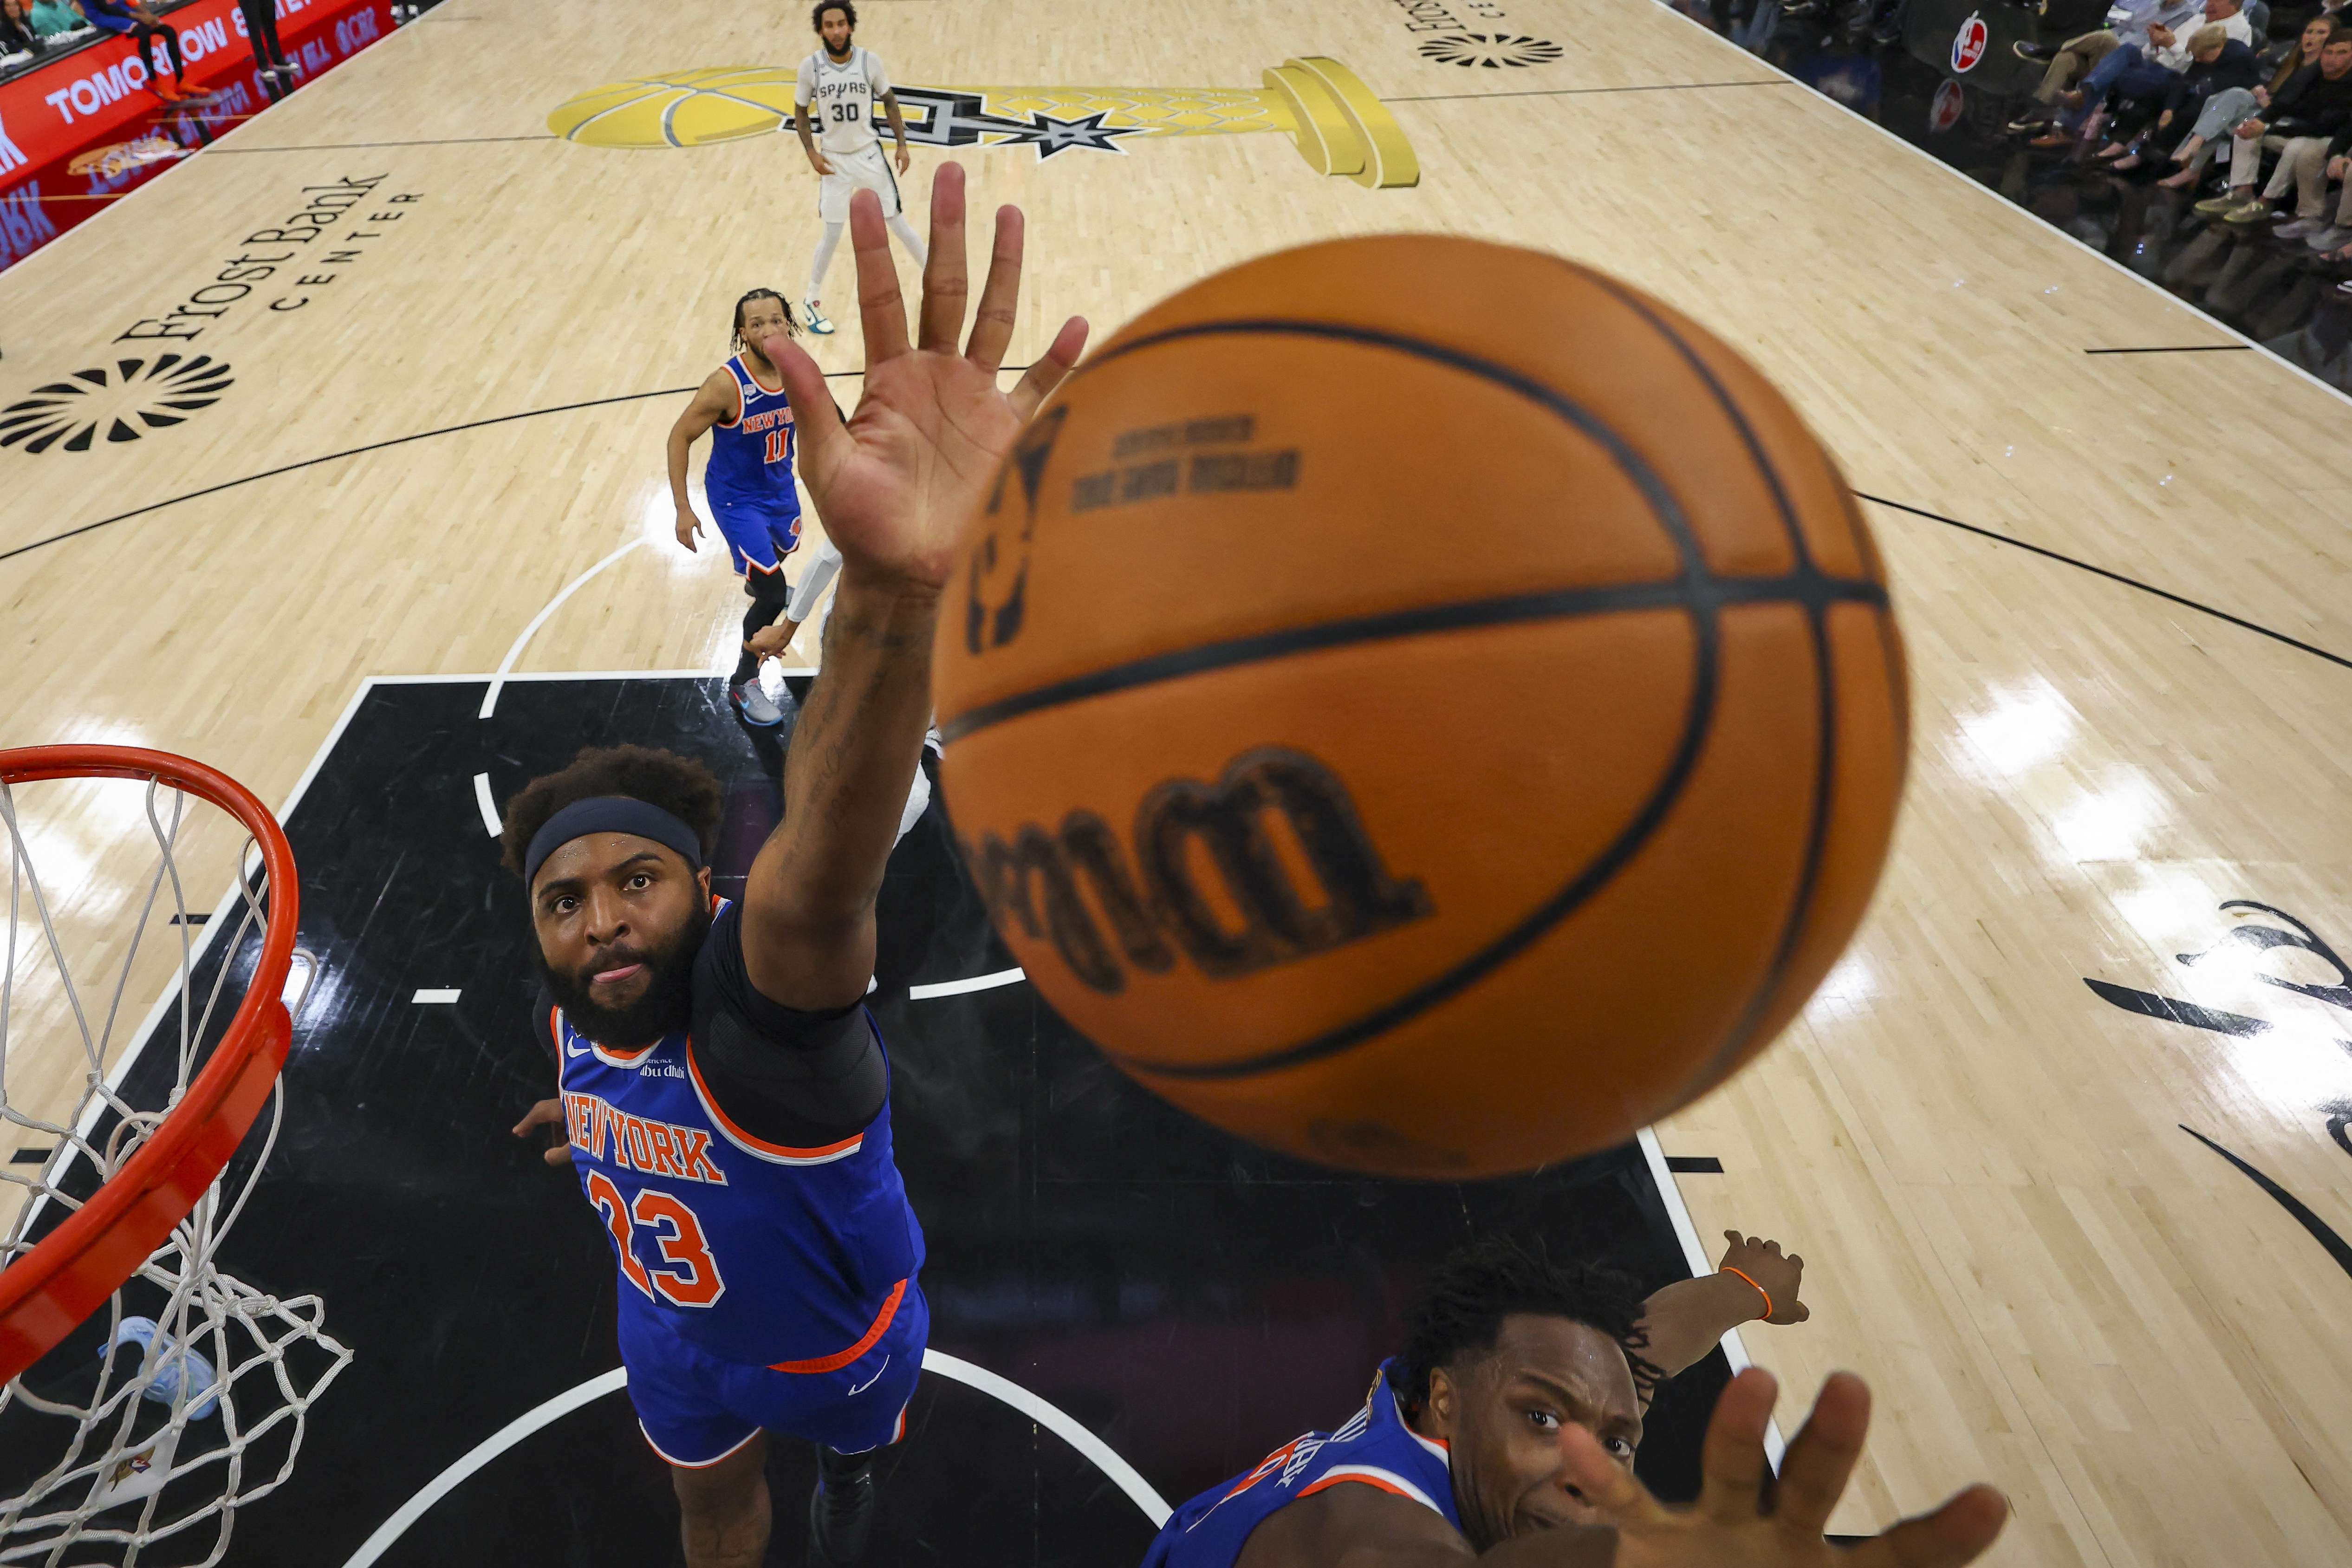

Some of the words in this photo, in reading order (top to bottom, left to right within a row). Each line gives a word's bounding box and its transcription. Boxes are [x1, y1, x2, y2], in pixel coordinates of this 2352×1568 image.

[820, 82, 867, 99] SPURS
[831, 103, 858, 122] 30
[269, 193, 425, 312] CENTER
[742, 410, 775, 435] NEW
[764, 427, 790, 465] 11
[640, 1064, 661, 1077] abu
[663, 1064, 684, 1079] dhabi
[563, 1091, 609, 1162] NEW
[605, 1106, 729, 1186] YORK
[586, 1168, 726, 1308] 23
